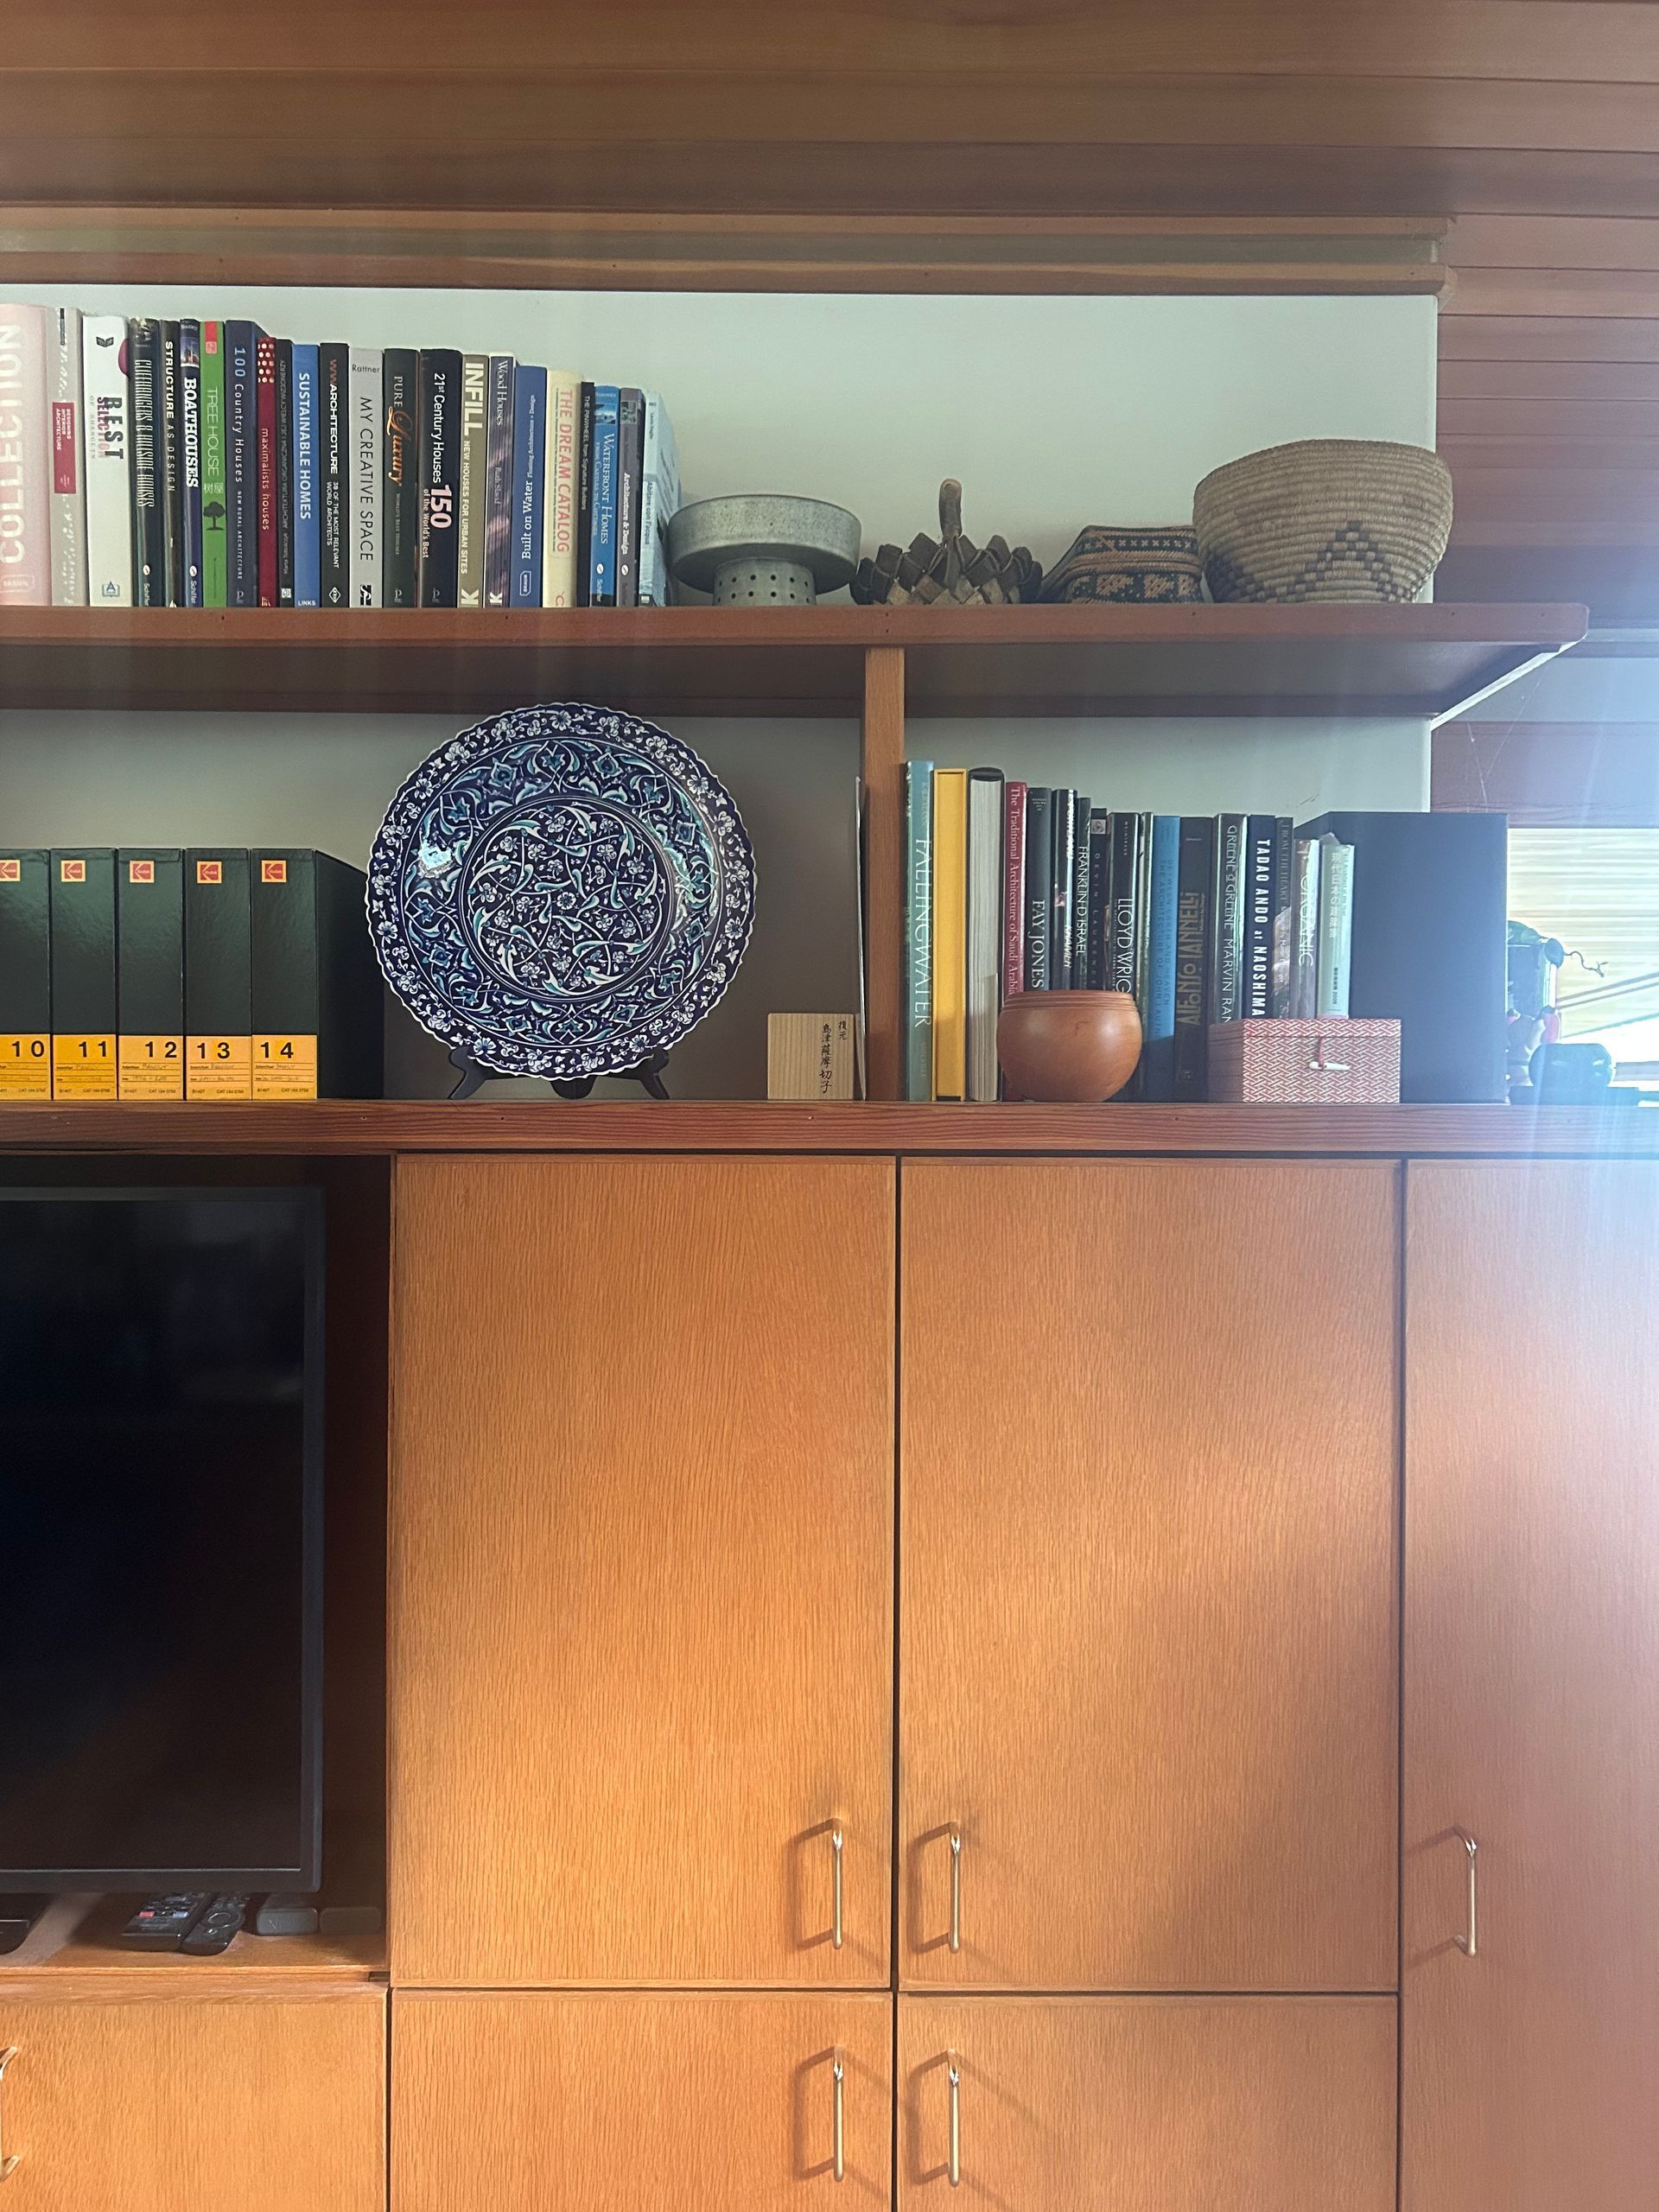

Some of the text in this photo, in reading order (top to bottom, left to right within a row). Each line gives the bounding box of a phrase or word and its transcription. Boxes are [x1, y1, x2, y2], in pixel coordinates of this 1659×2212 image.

[134, 359, 154, 421] CLIFFHANGERS
[352, 364, 380, 373] Rattner
[497, 359, 508, 426] Wood Houses
[165, 340, 175, 492] STRUCTURE AS DESIGN
[232, 346, 245, 482] 100 Country Houses
[464, 362, 484, 436] INFILL
[0, 325, 25, 563] COLLECTION
[97, 397, 110, 459] SELECTION
[104, 397, 124, 459] BEST
[136, 434, 154, 471] HILLSIDE
[183, 377, 199, 488] BOATHOUSES
[207, 386, 219, 476] TREE HOUSE
[299, 372, 311, 520] SUSTAINABLE HOMES
[386, 376, 414, 485] PURE Luxury
[430, 372, 446, 484] 21st Century Houses
[137, 474, 155, 507] HOUSES
[261, 428, 270, 531] maximalists houses
[333, 492, 340, 501] OF
[359, 397, 373, 561] MY CREATIVE SPACE
[423, 488, 430, 497] of
[522, 480, 533, 514] Water
[556, 389, 574, 552] THE DREAM CATALOG
[601, 433, 615, 544] WATERFRONT HOMES
[429, 484, 453, 529] 150
[524, 516, 532, 531] on
[521, 532, 531, 560] Built
[620, 530, 630, 555] Design
[1010, 785, 1020, 806] The
[1010, 809, 1020, 860] Traditional
[1225, 825, 1237, 871] GREENE
[1009, 862, 1020, 921] Architecture
[1076, 846, 1088, 957] FRANKLIN D ISRAEL
[1224, 884, 1236, 931] GREENE
[914, 839, 932, 1028] FALLINGWATER
[1009, 923, 1019, 934] of
[1009, 936, 1018, 961] Saudi
[1027, 899, 1046, 988] FAY JONES
[1116, 899, 1135, 994] LLOYD WRIG
[1251, 839, 1271, 1016] TADAO ANDO at NAOSHIMA
[1222, 938, 1233, 991] MARVIN
[1221, 998, 1232, 1023] RAN
[12, 1040, 45, 1058] 10
[79, 1040, 107, 1058] 11
[145, 1041, 177, 1058] 12
[197, 1042, 231, 1059] 13
[260, 1041, 294, 1058] 14
